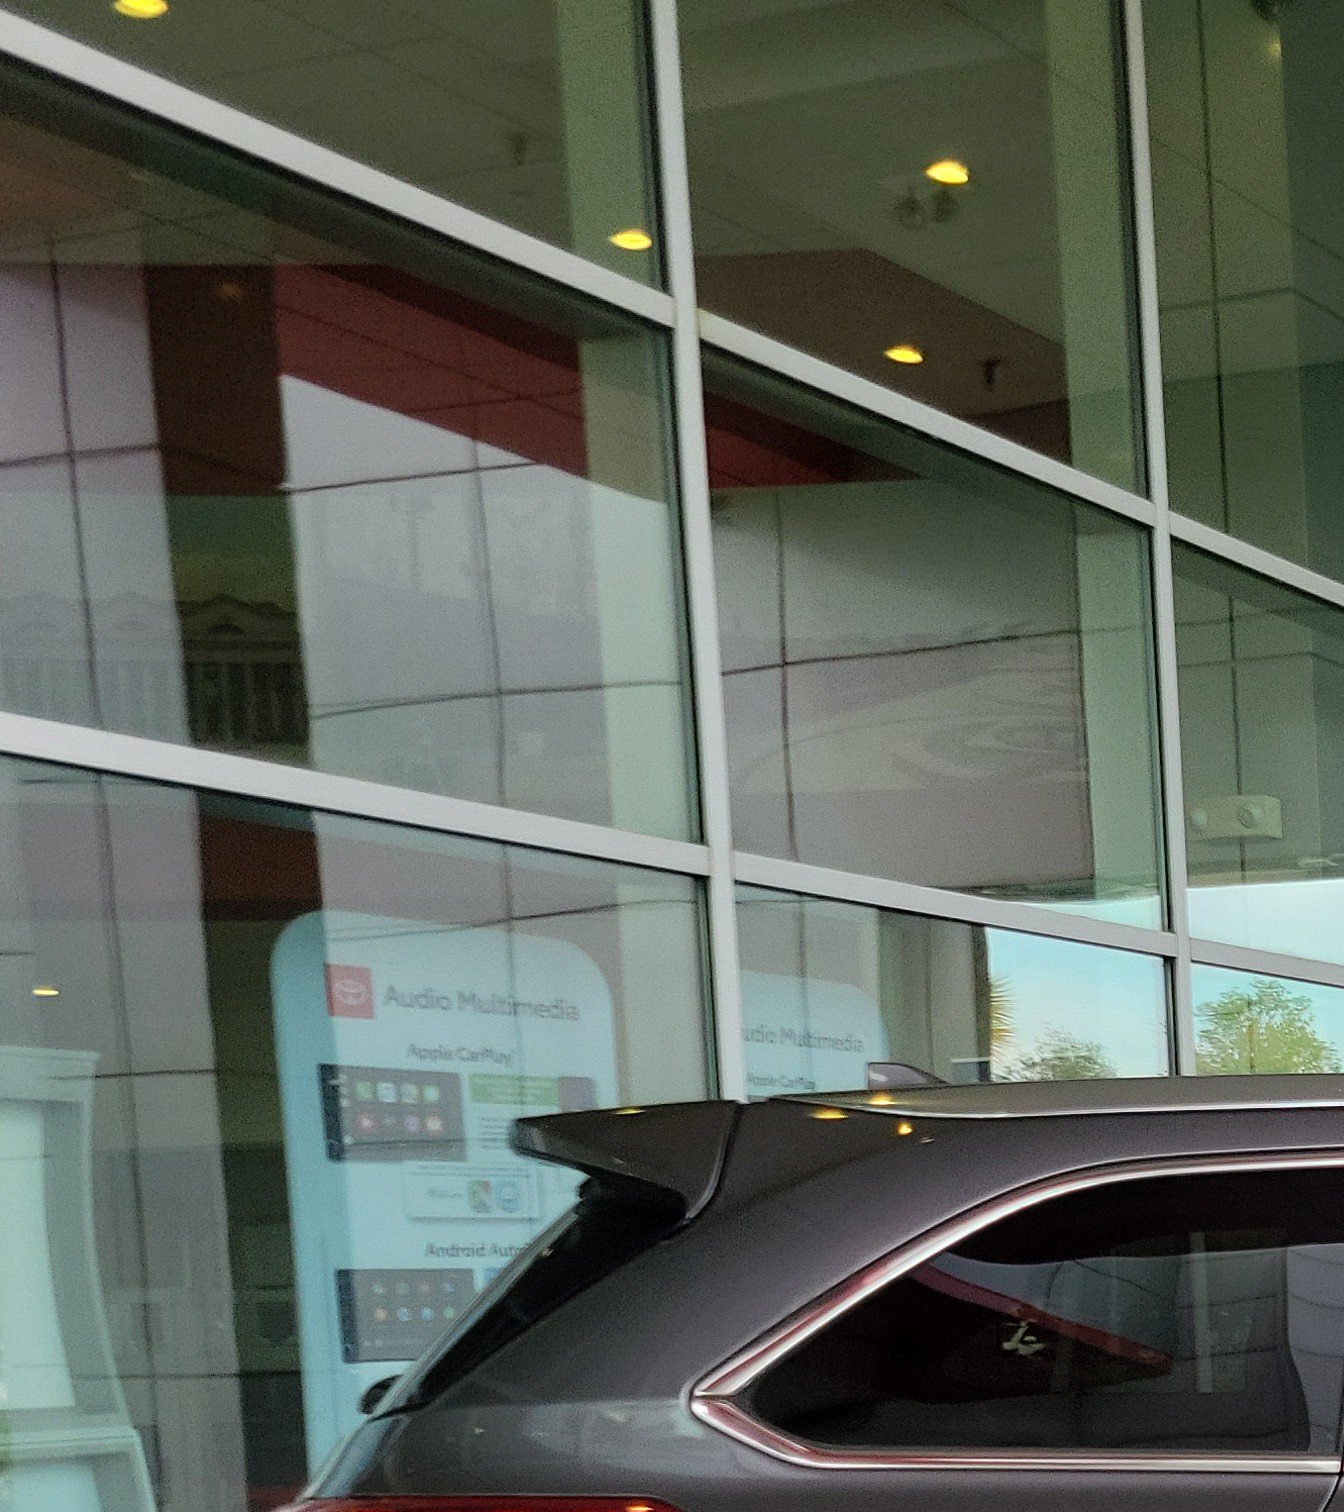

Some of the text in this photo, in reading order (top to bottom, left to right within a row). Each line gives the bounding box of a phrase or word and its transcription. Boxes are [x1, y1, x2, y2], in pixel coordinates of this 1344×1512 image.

[384, 985, 581, 1021] Audio Multimedia
[742, 1024, 776, 1044] udio
